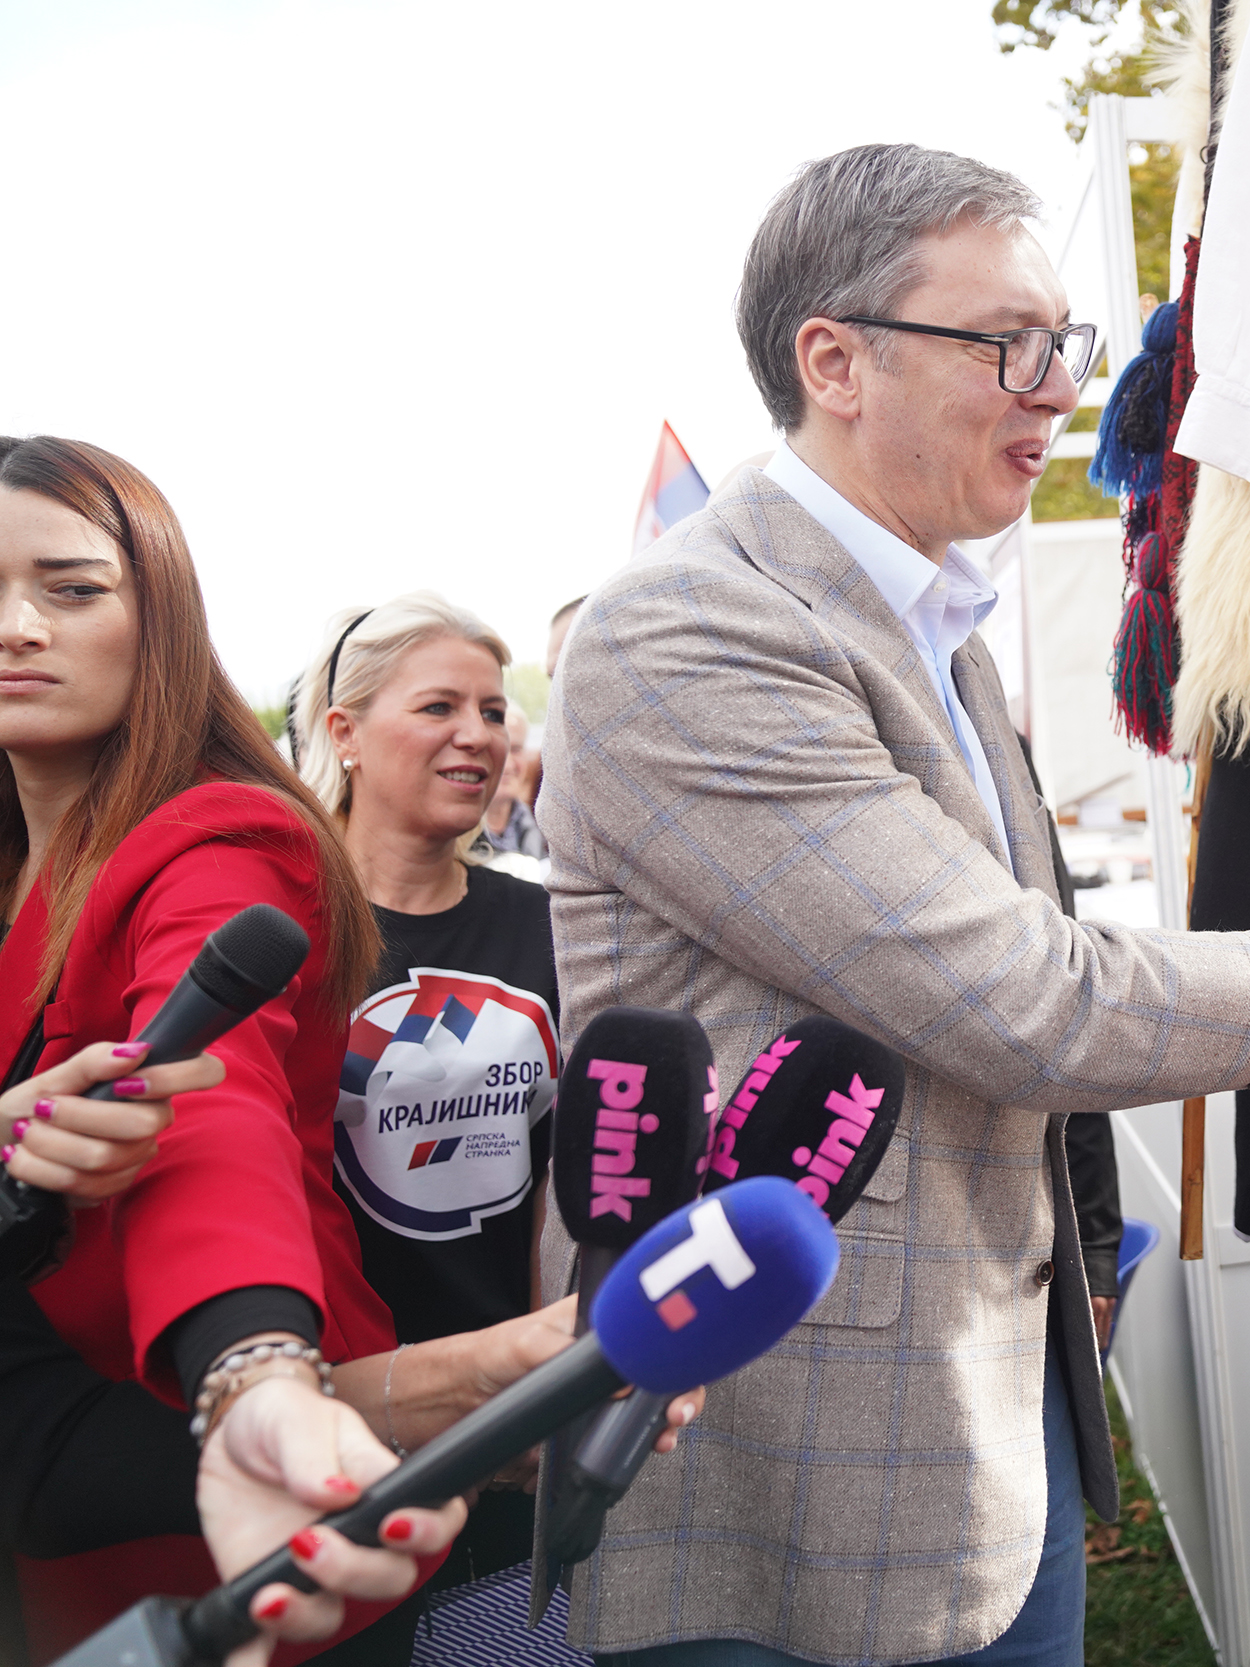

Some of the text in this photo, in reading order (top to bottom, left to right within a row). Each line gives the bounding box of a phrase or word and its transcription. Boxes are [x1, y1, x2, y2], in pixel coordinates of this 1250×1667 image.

[485, 1061, 543, 1087] ЗБОР
[466, 1132, 506, 1142] СРПСКА
[586, 1058, 660, 1223] pink
[465, 1139, 521, 1150] НАПРЕДНА
[464, 1149, 511, 1159] СТРАНКА
